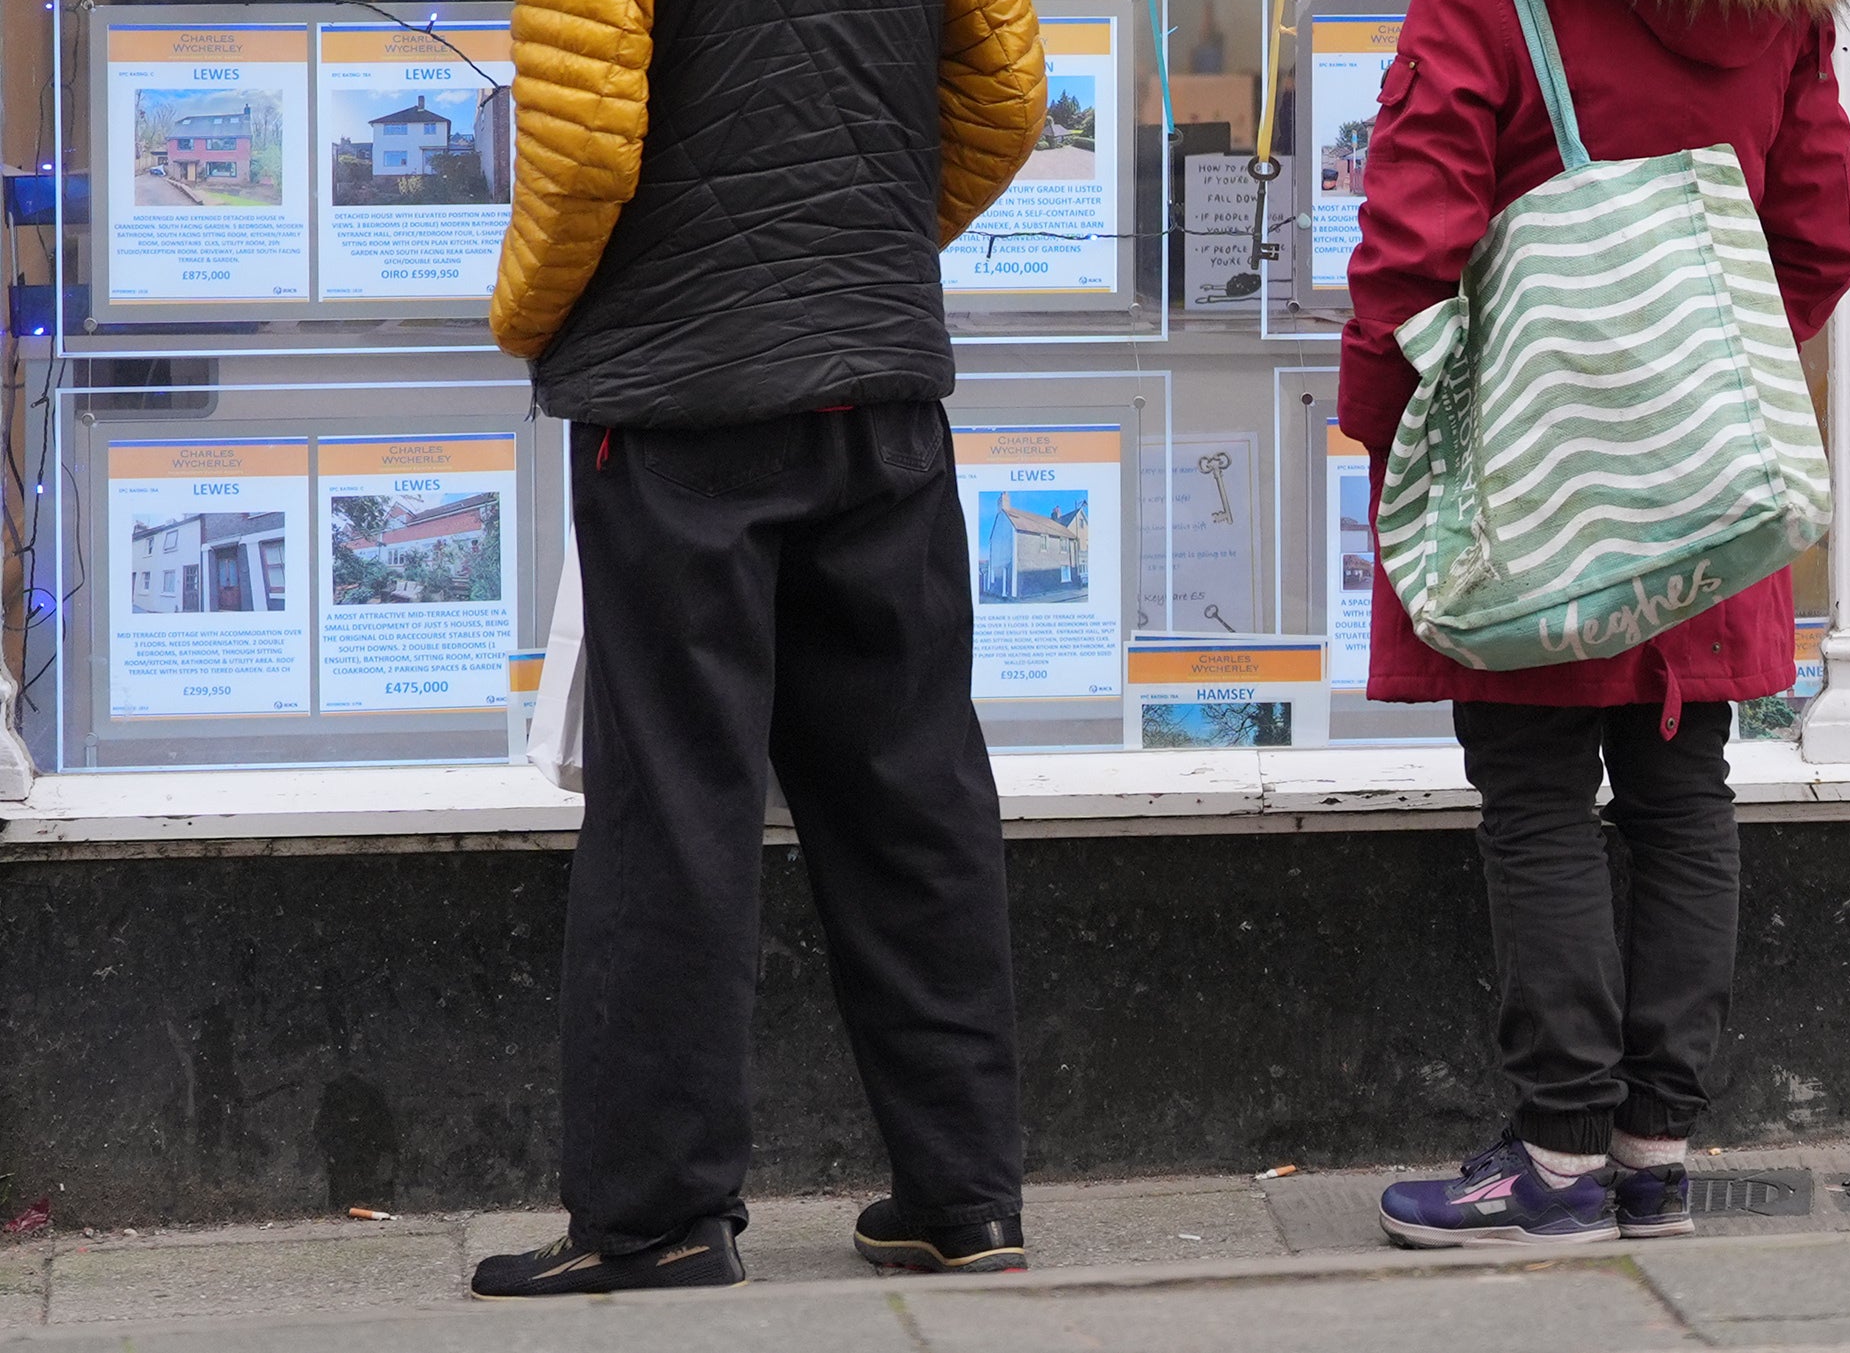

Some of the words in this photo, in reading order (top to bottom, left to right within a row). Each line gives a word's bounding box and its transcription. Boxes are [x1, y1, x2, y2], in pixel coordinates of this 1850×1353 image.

[181, 34, 234, 42] CHARLES
[173, 44, 243, 52] WYCHERLEY
[194, 69, 239, 80] LEWES
[406, 69, 451, 79] LEWES
[1199, 164, 1220, 172] HOW
[1208, 194, 1231, 203] FALL
[1237, 194, 1257, 203] DOW
[975, 262, 1048, 273] £1,400,000
[183, 271, 230, 280] £875,000
[381, 270, 408, 278] OIRO
[412, 270, 459, 278] £599,950
[180, 450, 236, 458] CHARLES
[389, 446, 443, 454] CHARLES
[990, 446, 1058, 454] WYCHERLEY
[172, 459, 242, 467] WYCHERLEY
[1011, 470, 1055, 481] LEWES
[194, 484, 239, 495] LEWES
[395, 480, 440, 491] LEWES
[1199, 655, 1251, 663] CHARLES
[1001, 671, 1047, 679] £925,000
[184, 687, 231, 695] £299,950
[386, 682, 448, 693] £475,000
[1197, 689, 1254, 699] HAMSEY
